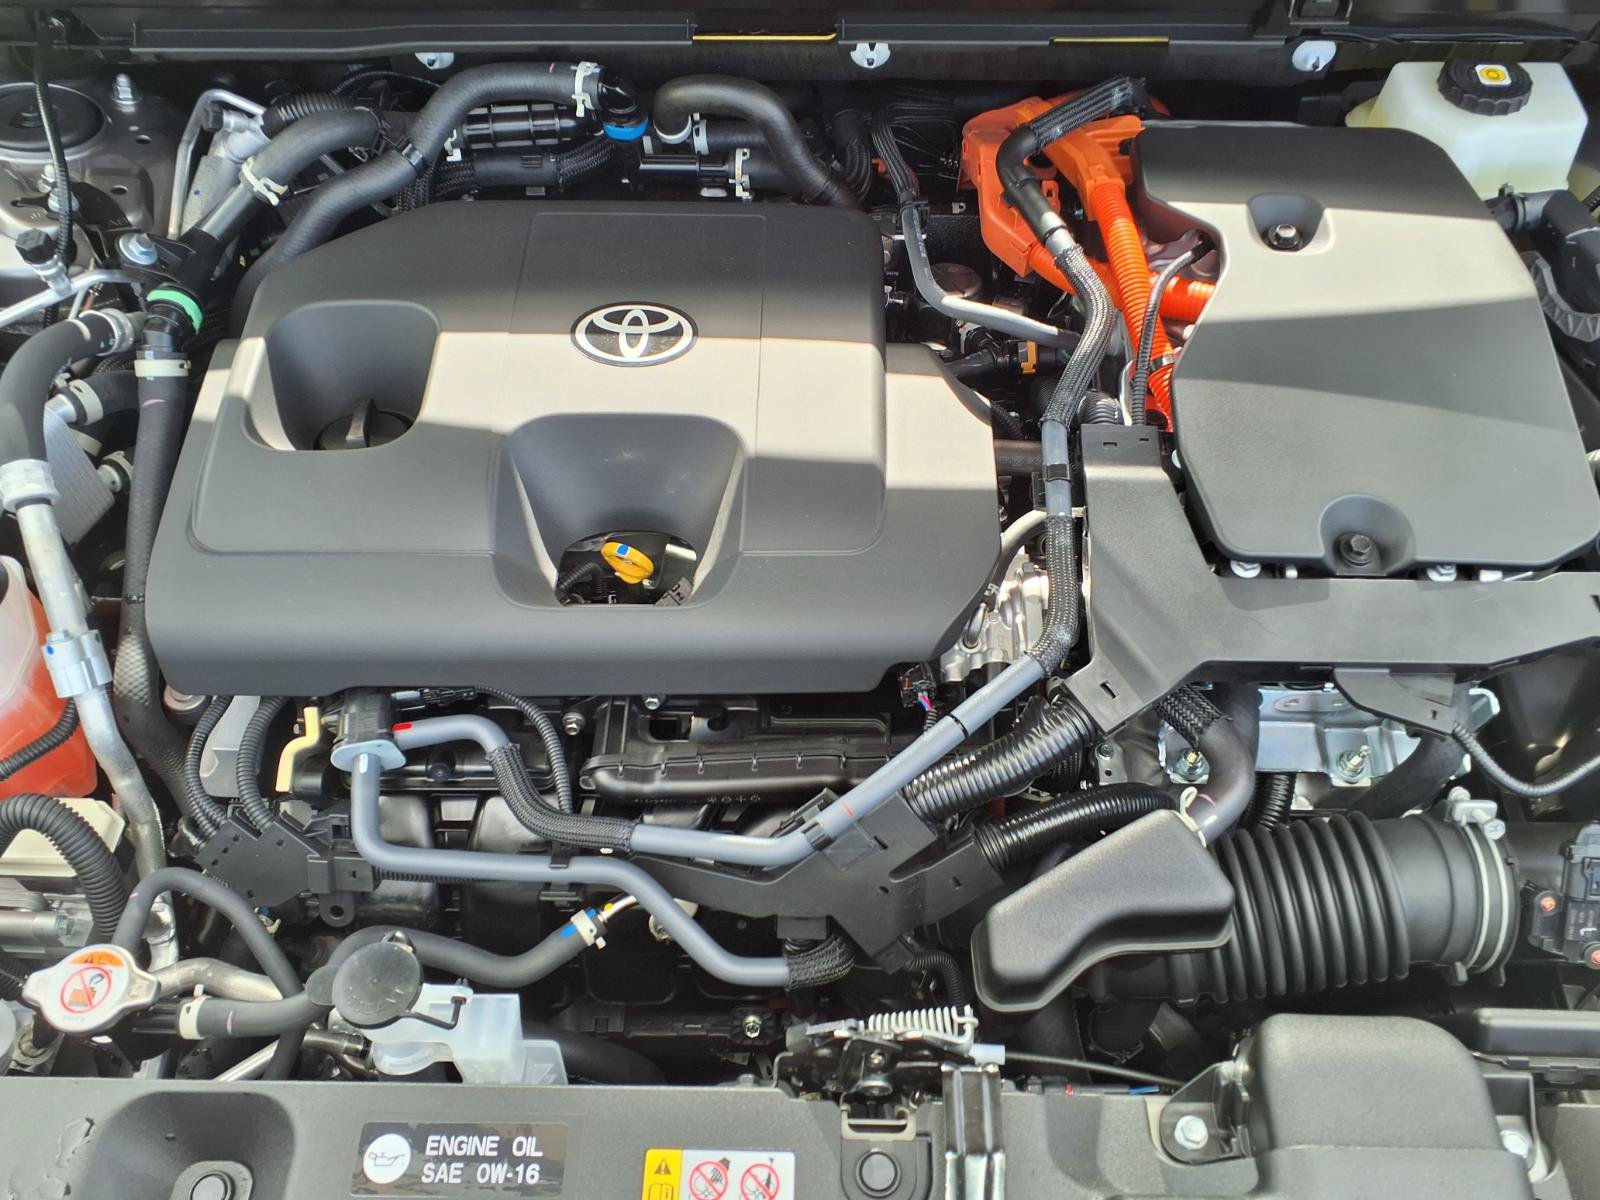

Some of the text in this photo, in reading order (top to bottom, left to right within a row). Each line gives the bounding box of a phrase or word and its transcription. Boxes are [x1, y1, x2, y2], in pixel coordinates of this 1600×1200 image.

[425, 1135, 544, 1157] ENGINE OIL
[421, 1162, 540, 1184] SAE 0W-16
